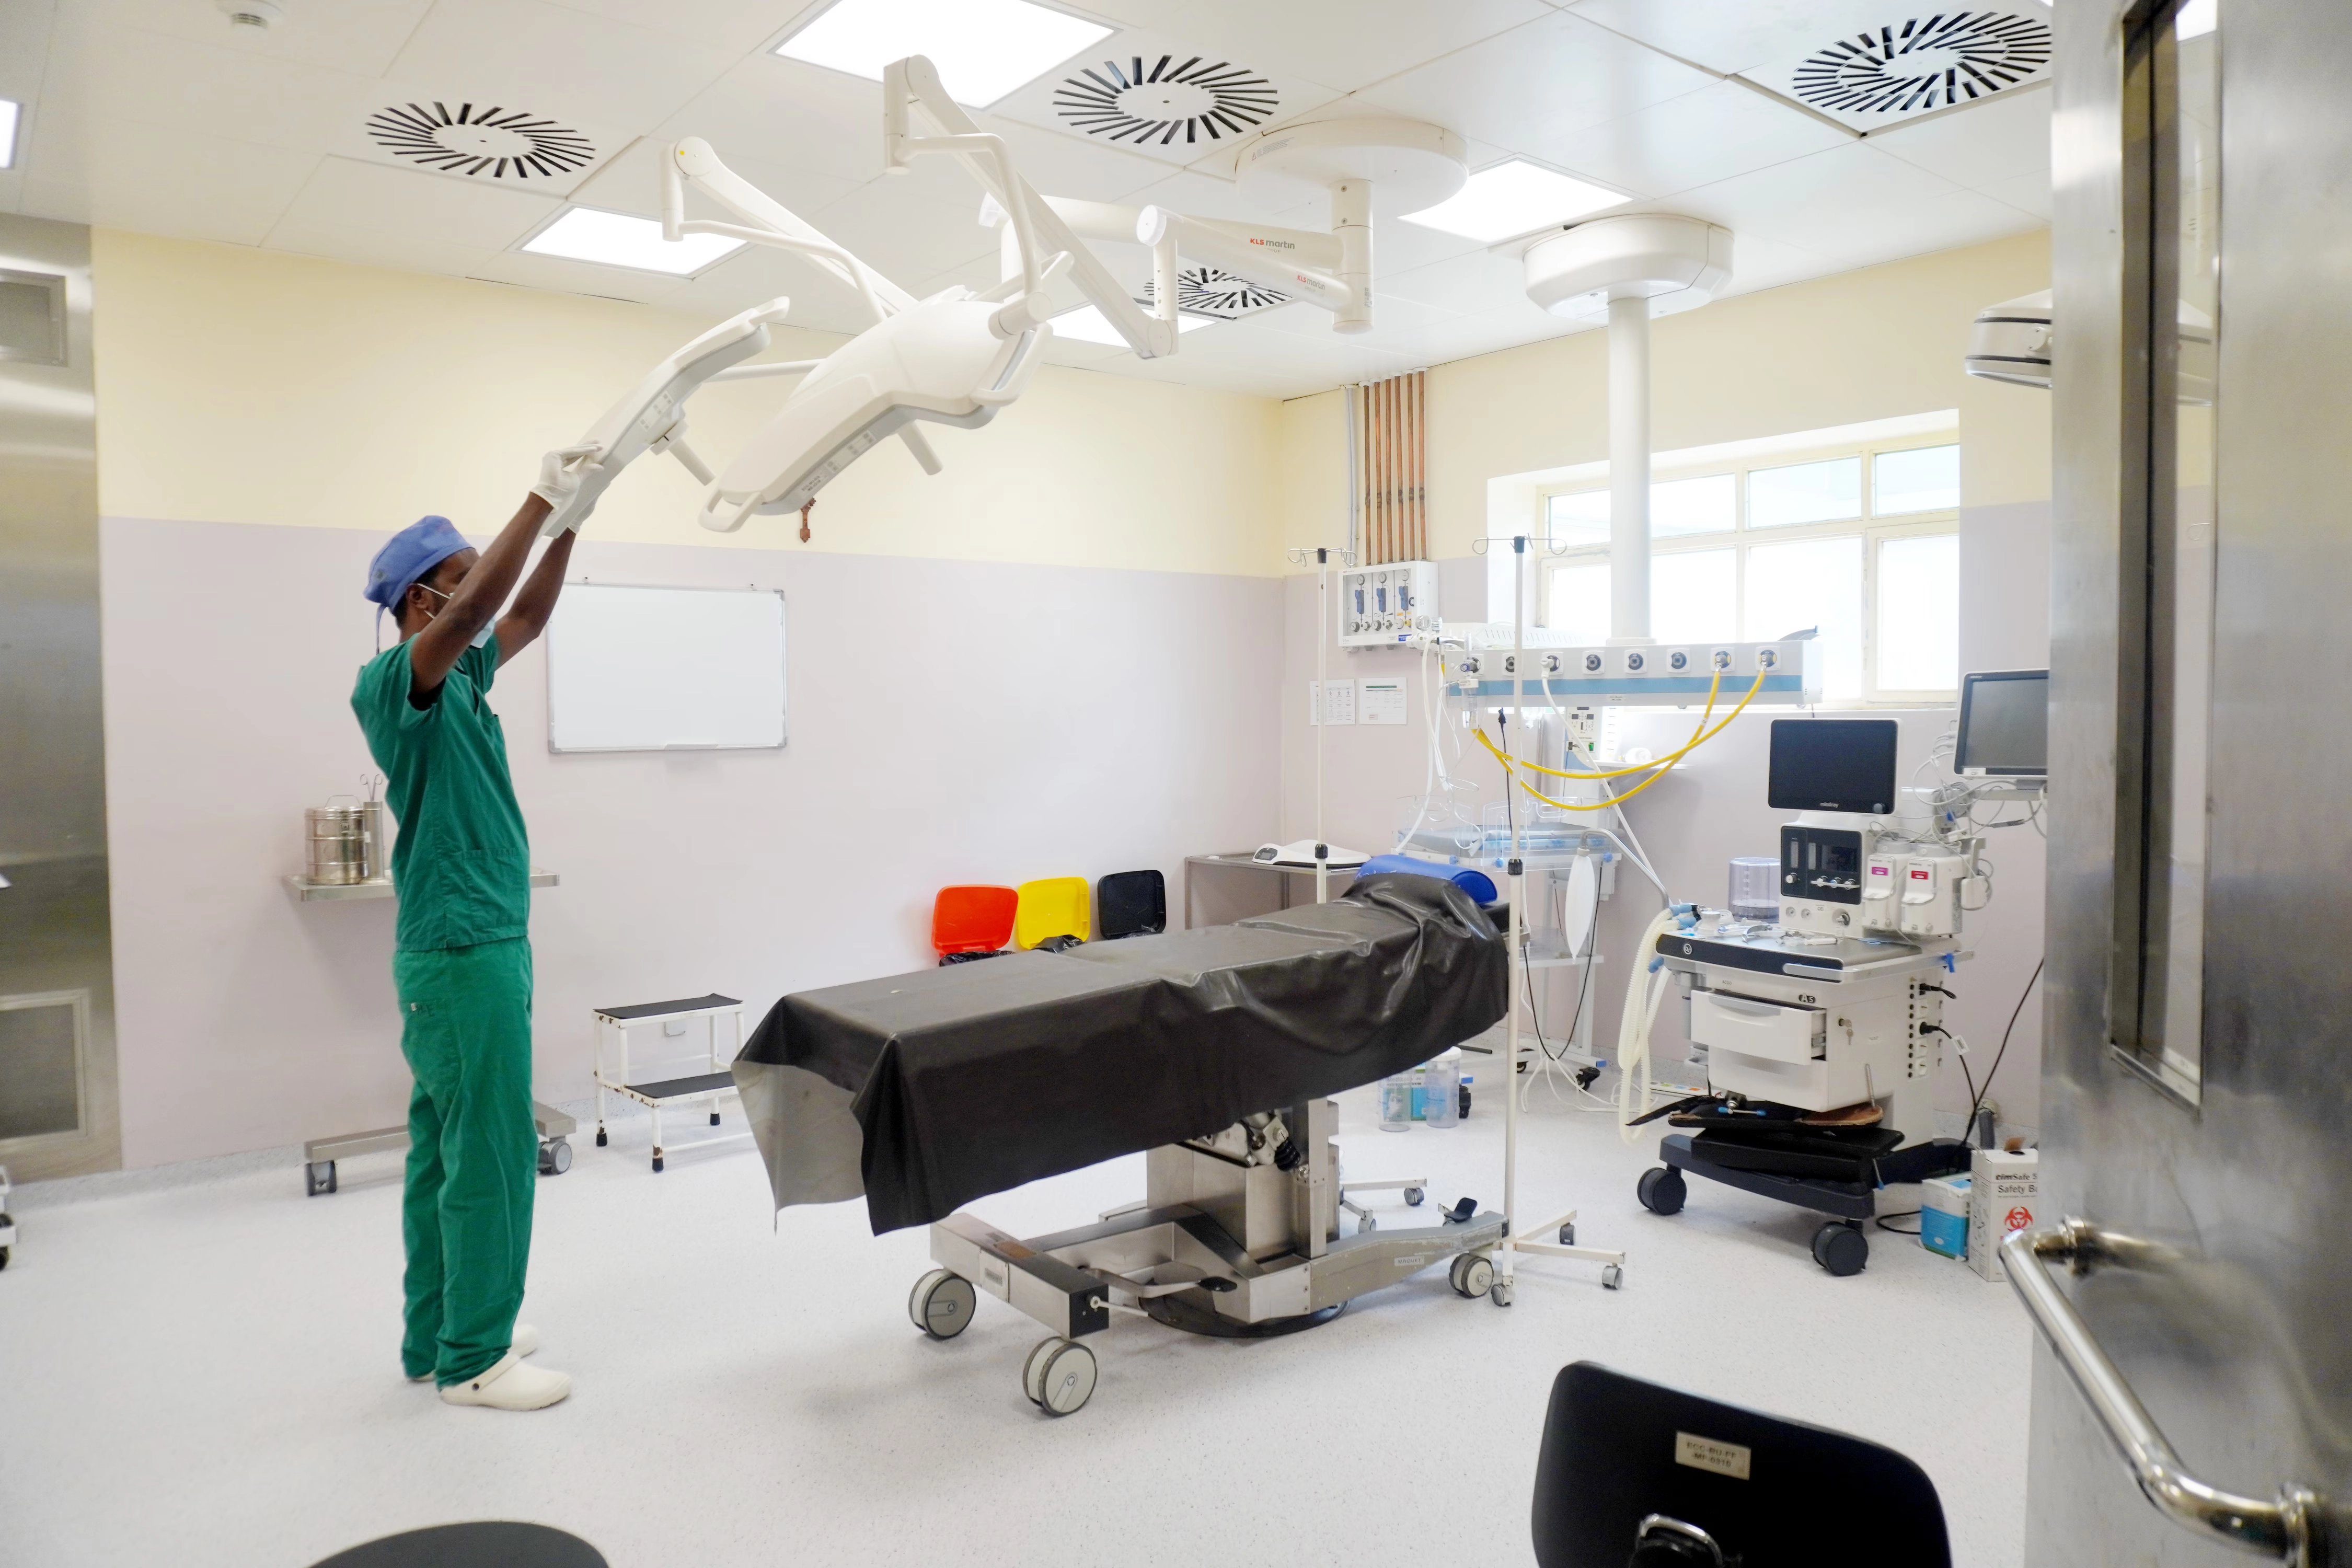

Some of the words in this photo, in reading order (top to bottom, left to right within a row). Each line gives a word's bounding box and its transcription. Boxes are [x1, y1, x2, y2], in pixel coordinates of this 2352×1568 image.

[1265, 240, 1295, 249] martin
[1297, 274, 1307, 283] KLS
[1307, 278, 1325, 291] martin
[1801, 993, 1815, 1004] A5
[1998, 1185, 2024, 1195] Safety
